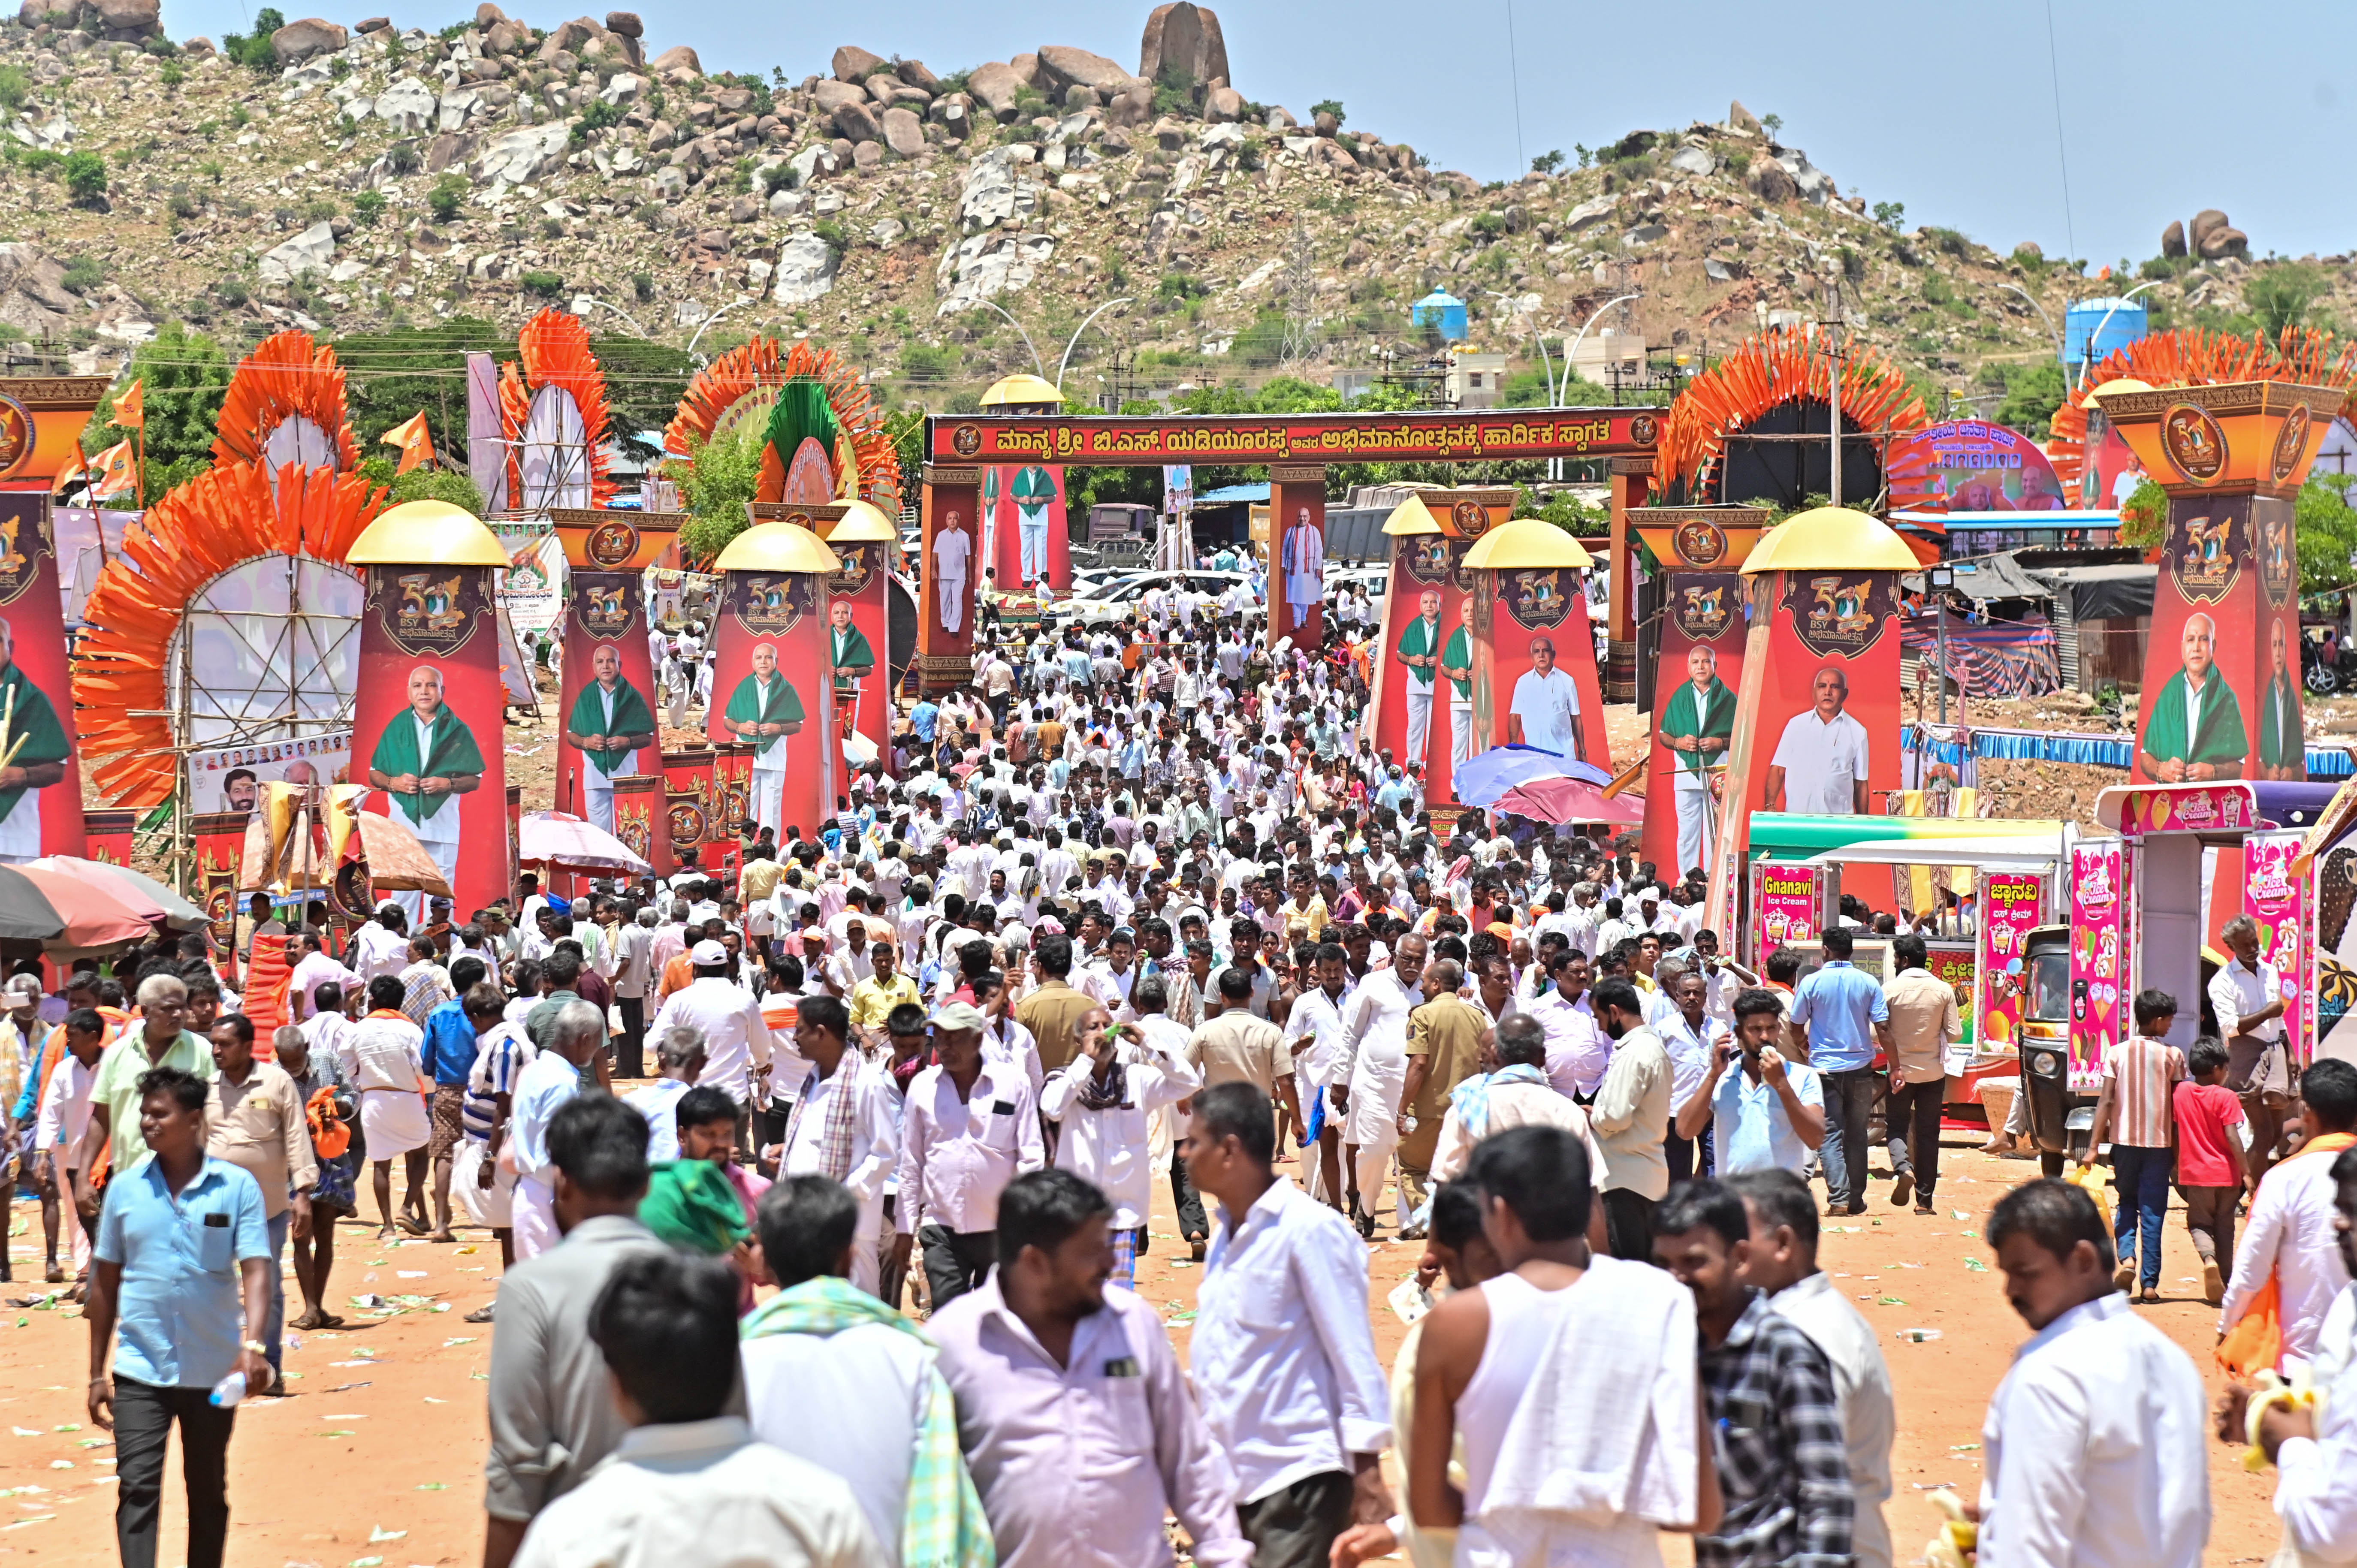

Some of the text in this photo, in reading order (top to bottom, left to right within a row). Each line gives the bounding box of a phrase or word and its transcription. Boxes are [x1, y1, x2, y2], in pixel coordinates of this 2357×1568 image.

[997, 420, 1610, 459] ಮಾನ್ಯ ಶ್ರೀ ಬಿ.ಎಸ್. ಯಡಿಯೂರಪ್ಪ ಅವರ ಅಭಿಮಾನೋತ್ಸವಕ್ಕೆ ಹಾರ್ದಿಕ ಸ್ವಾಗತ
[1960, 422, 1986, 437] ಜನತಾ
[1990, 428, 2016, 447] ಪಾರ್ಟಿ
[2185, 564, 2197, 573] BSY
[401, 618, 419, 626] BSY
[1811, 620, 1828, 629] BSY
[2191, 802, 2206, 812] Ice
[2182, 810, 2212, 820] Cream
[1765, 876, 1811, 896] Gnanavi
[2090, 881, 2105, 895] Ice
[2264, 875, 2282, 889] Ice
[1990, 881, 2037, 909] ಜ್ಞಾನವಿ
[2083, 891, 2109, 905] Cream
[2256, 884, 2288, 899] Cream
[1768, 896, 1807, 905] Ice Cream
[1993, 909, 2032, 921] ಐಸ್ ಕ್ರೀಮ್
